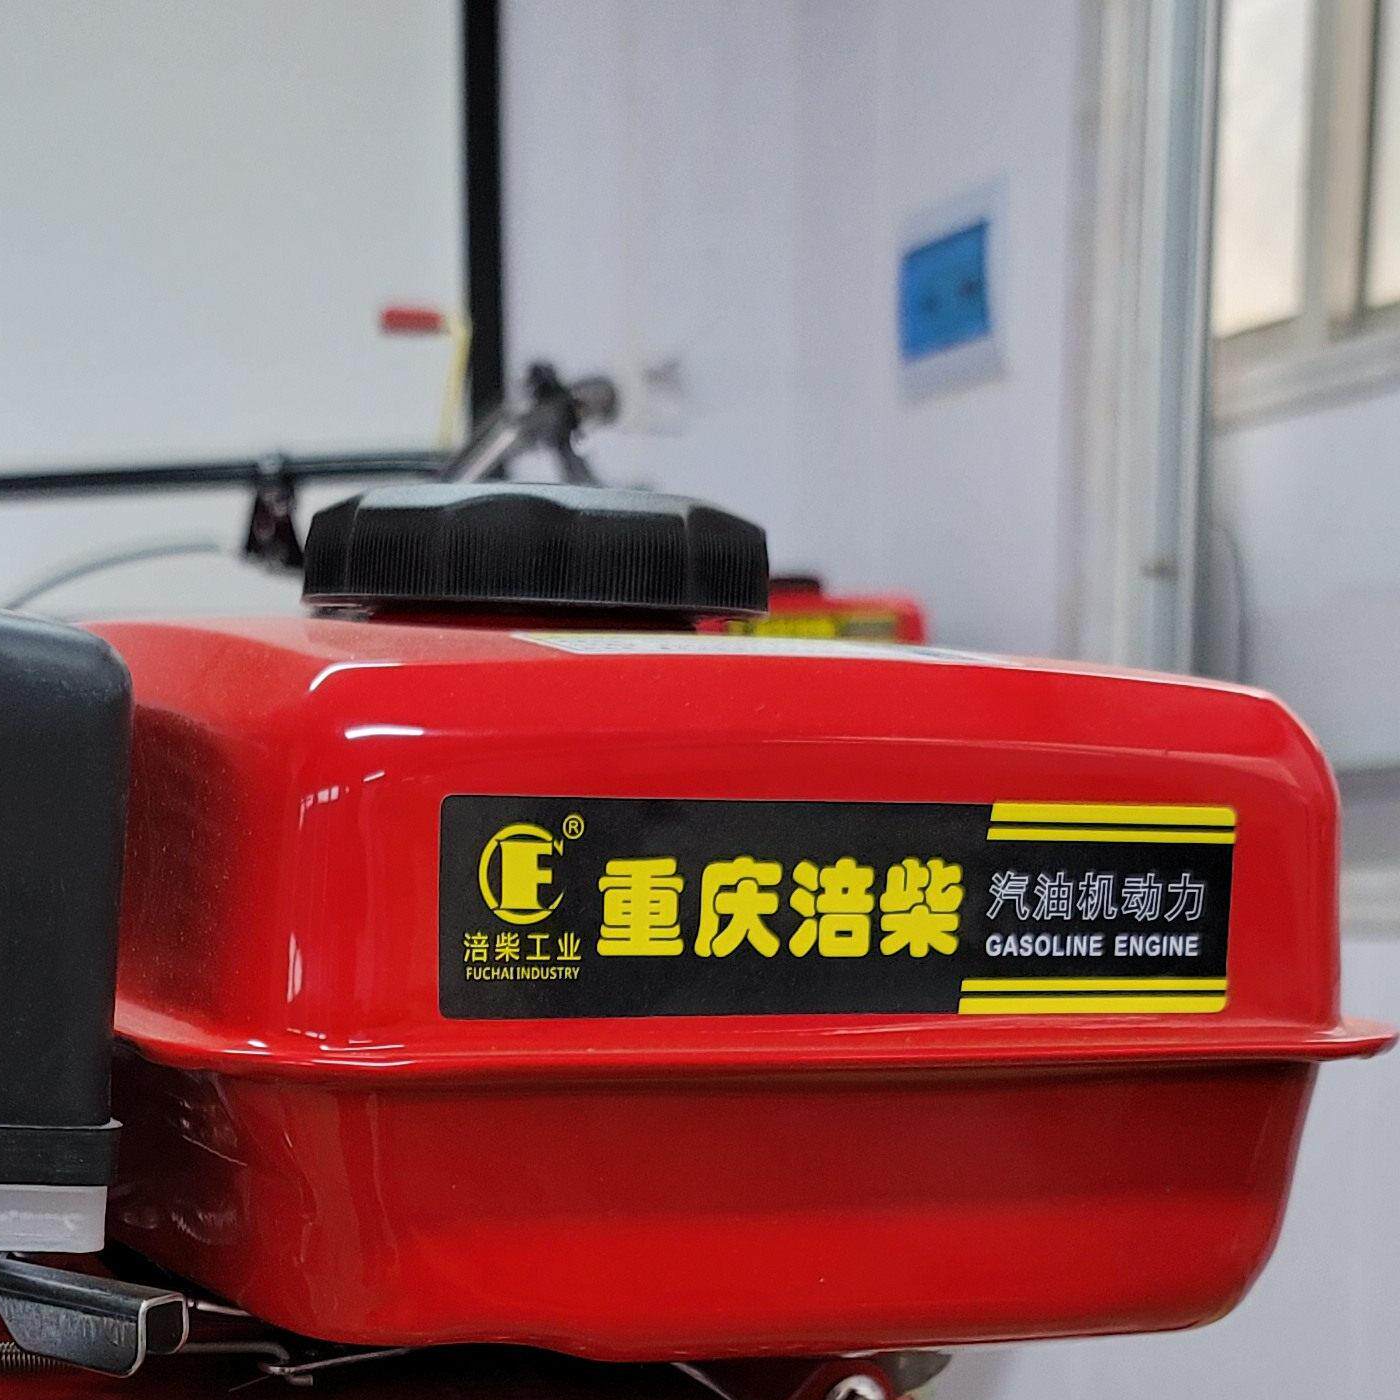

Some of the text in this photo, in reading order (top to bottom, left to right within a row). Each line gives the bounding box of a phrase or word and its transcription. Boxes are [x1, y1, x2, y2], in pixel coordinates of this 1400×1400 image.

[597, 856, 967, 961] 重庆涪柴
[986, 870, 1205, 922] 汽油机动力
[463, 931, 582, 963] 涪柴工业
[985, 935, 1200, 957] GASOLINE ENGINE
[466, 966, 581, 980] FUCHAI INDUSTRY
